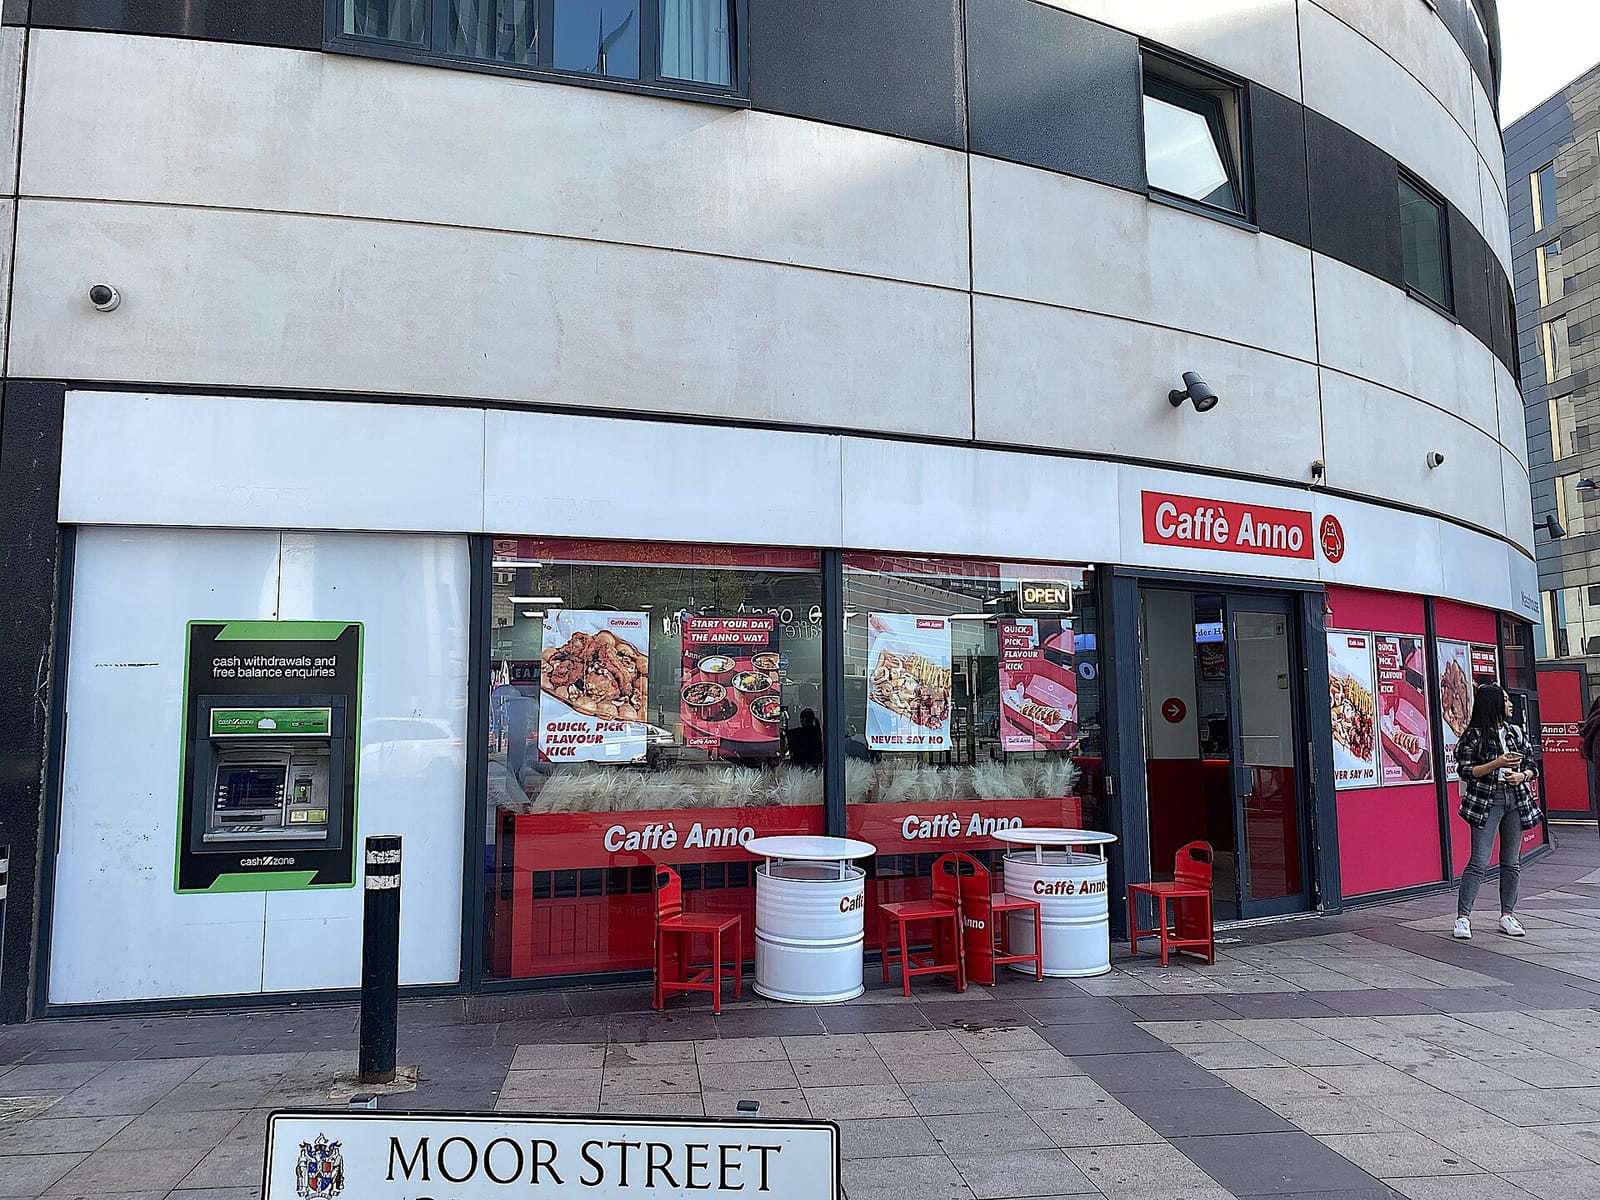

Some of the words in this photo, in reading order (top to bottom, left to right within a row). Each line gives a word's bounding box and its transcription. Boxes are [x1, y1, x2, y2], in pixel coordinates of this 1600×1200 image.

[1155, 501, 1229, 544] Caffè
[1236, 512, 1303, 552] Anno
[1024, 588, 1067, 603] OPEN
[691, 620, 719, 629] START
[722, 620, 748, 629] YOUR
[751, 620, 772, 630] DAY,
[1004, 626, 1030, 634] QUICK,
[691, 633, 709, 642] THE
[711, 633, 740, 642] ANNO
[742, 633, 766, 642] WAY.
[1004, 650, 1038, 658] FLAVOUR
[212, 656, 241, 667] cash
[244, 656, 312, 667] withdrawals
[314, 656, 337, 667] and
[1005, 663, 1023, 671] KICK
[213, 667, 236, 678] free
[238, 667, 283, 678] balance
[285, 667, 336, 679] enquiries
[1380, 671, 1403, 680] FLAVOUR
[1381, 685, 1394, 693] KICK
[546, 722, 590, 734] QUICK,
[595, 722, 624, 732] PICK
[1541, 726, 1564, 734] Anno
[546, 734, 603, 744] FLAVOUR
[871, 735, 904, 744] NEVER
[906, 735, 925, 744] SAY
[928, 736, 944, 744] NO
[546, 747, 577, 757] KICK
[1350, 769, 1362, 779] SAY
[1364, 769, 1374, 778] NO
[902, 812, 961, 840] Caffè
[965, 813, 1023, 837] Anno
[604, 822, 677, 852] Caffè
[683, 822, 755, 849] Anno
[1033, 880, 1075, 895] Caffè
[1078, 880, 1105, 895] Anno
[386, 1136, 564, 1185] MOOR
[579, 1139, 782, 1191] STREET
